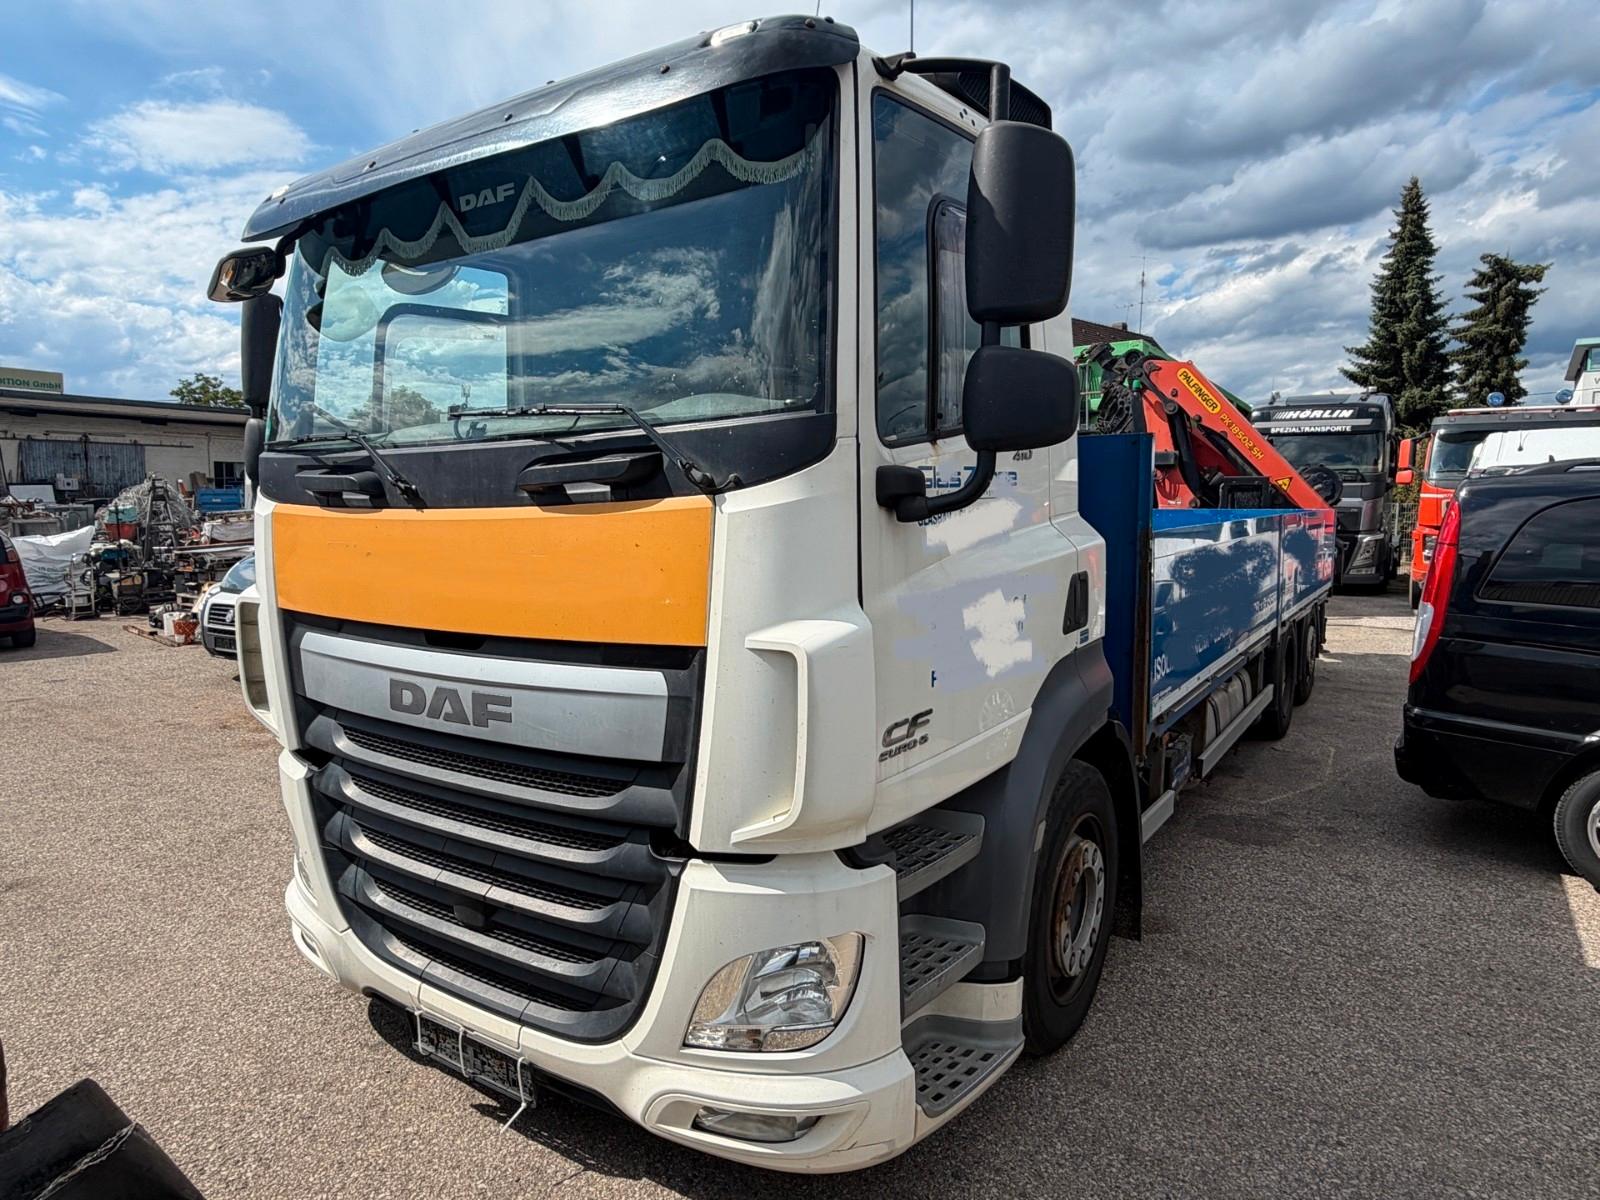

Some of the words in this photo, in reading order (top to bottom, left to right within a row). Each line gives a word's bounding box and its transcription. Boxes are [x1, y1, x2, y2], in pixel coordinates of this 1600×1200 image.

[459, 182, 515, 213] DAF
[32, 380, 61, 389] GmbH
[1179, 370, 1219, 412] PALFINGER
[1270, 425, 1352, 434] SPEZIALTRANSPORTE
[1285, 408, 1354, 420] HÖRLIN
[1220, 413, 1233, 427] PK
[1229, 422, 1255, 449] 18502
[1250, 447, 1265, 461] SH
[389, 678, 513, 728] DAF
[882, 708, 933, 748] CF
[918, 733, 929, 746] 6
